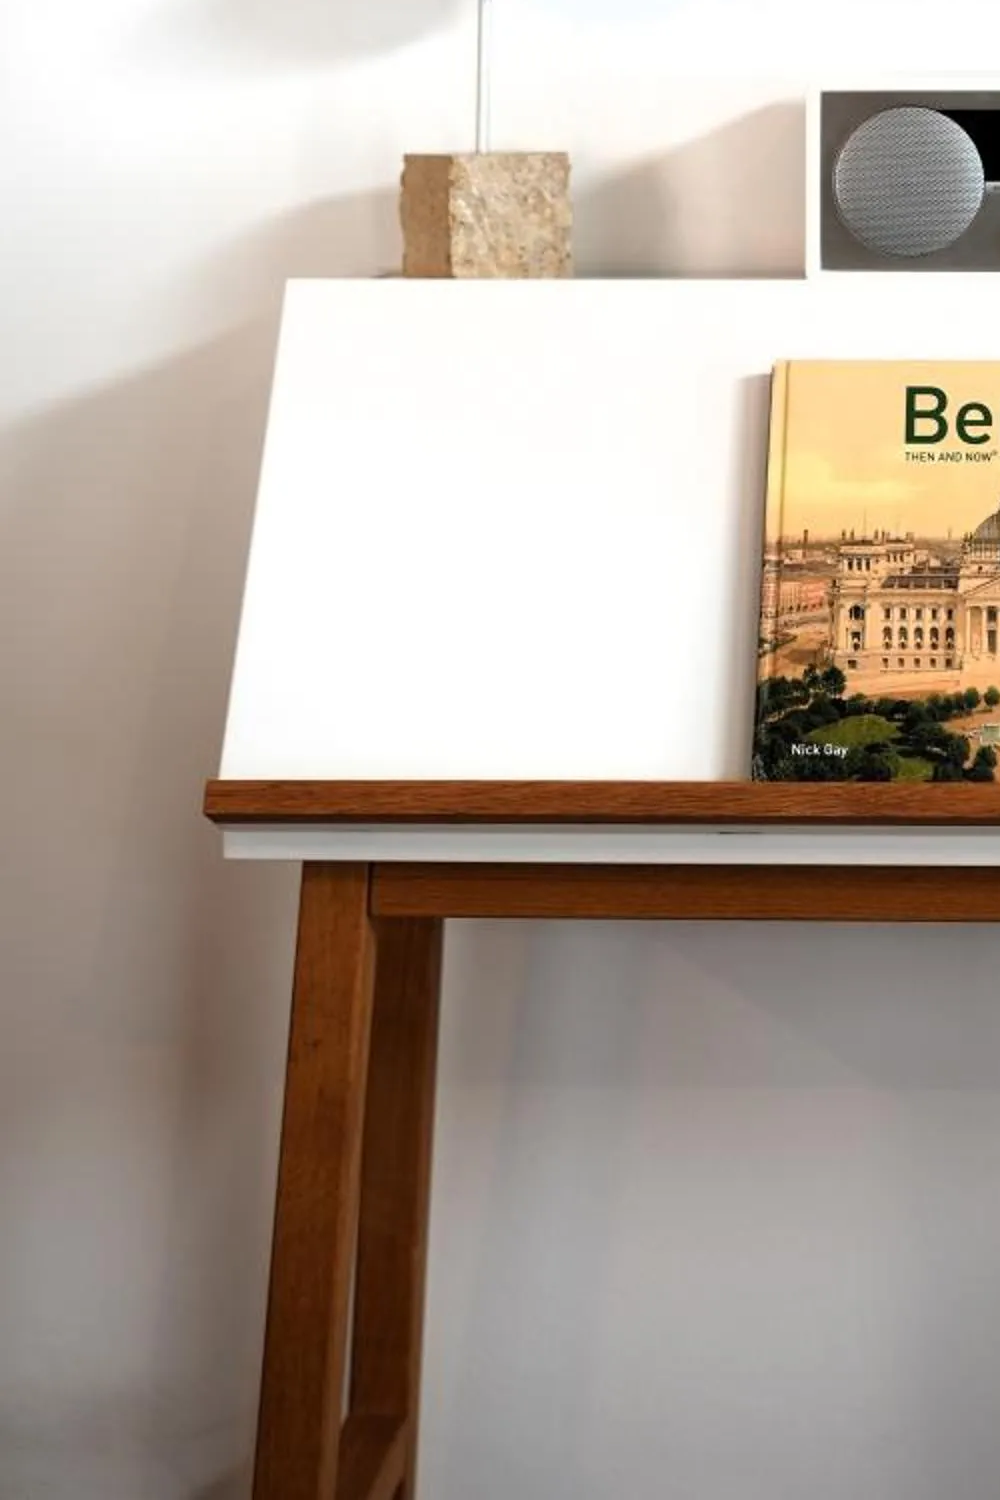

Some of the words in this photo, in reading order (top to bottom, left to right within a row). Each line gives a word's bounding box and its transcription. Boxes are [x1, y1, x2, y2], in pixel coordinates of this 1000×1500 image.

[905, 452, 935, 462] THEN
[938, 452, 963, 462] AND
[791, 743, 820, 756] Nick
[824, 743, 849, 759] Gay
